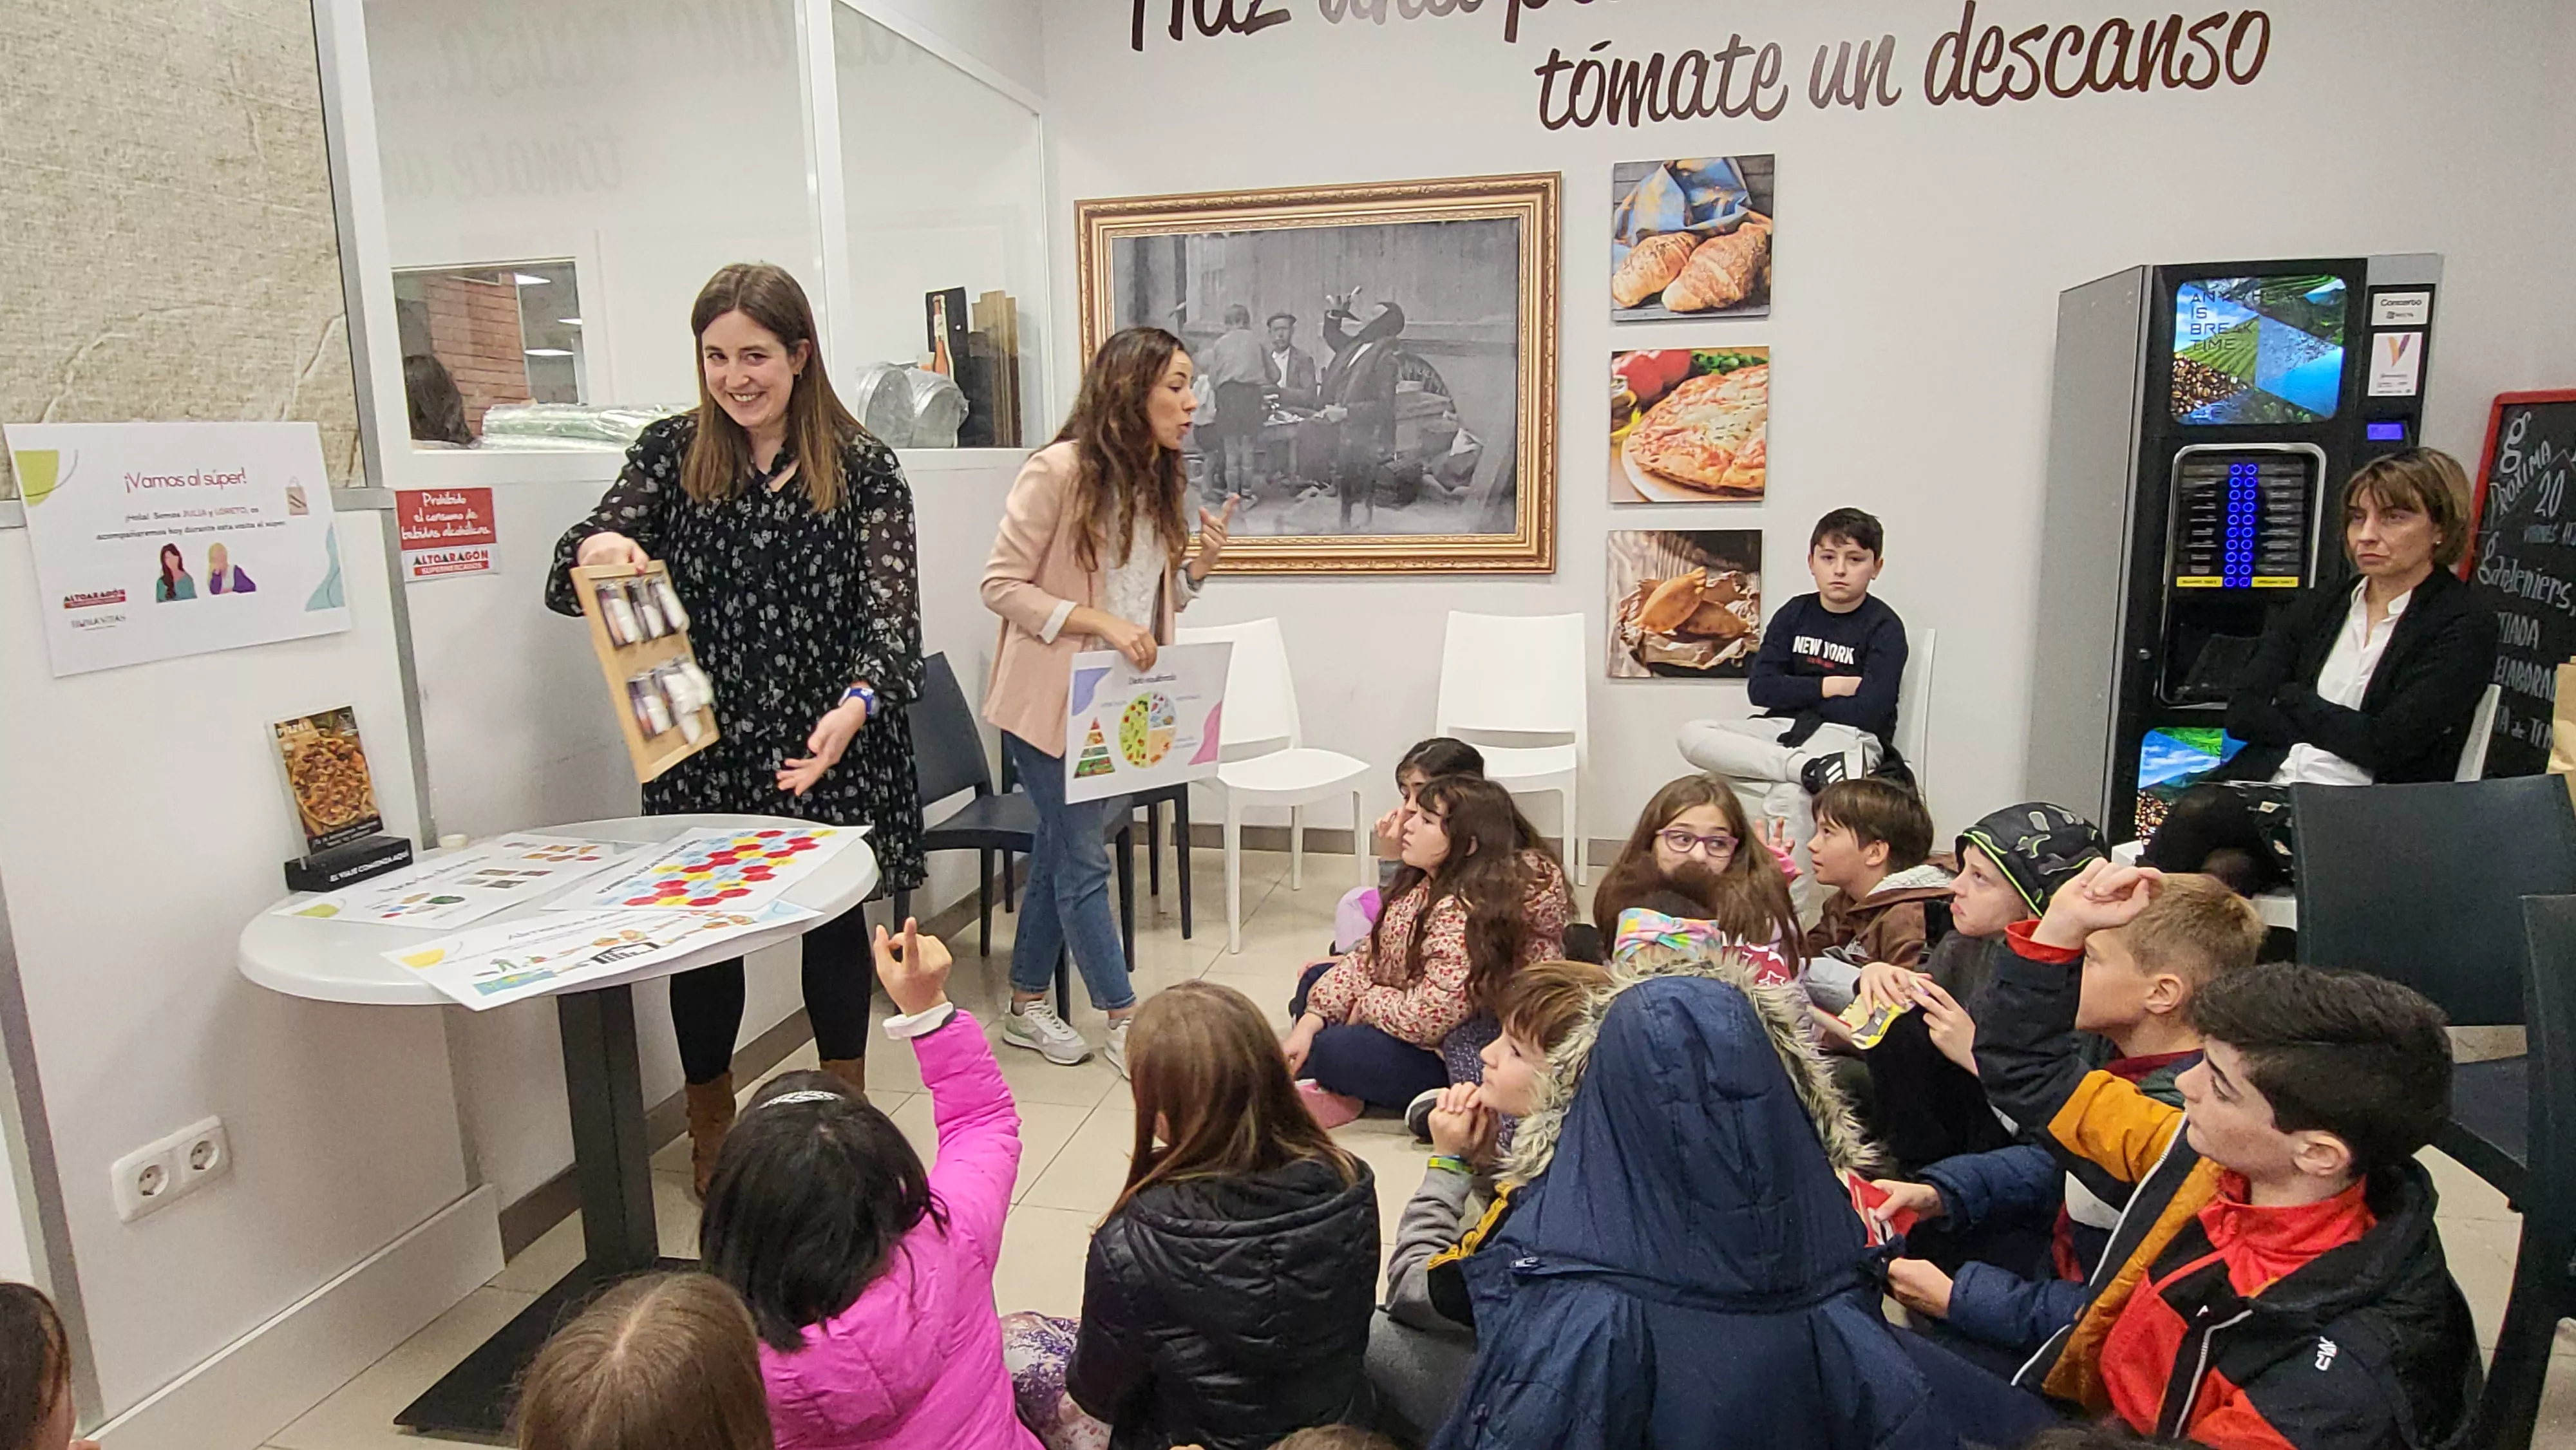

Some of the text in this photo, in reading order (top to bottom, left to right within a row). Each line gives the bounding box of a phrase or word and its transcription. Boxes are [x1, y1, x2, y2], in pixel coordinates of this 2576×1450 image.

[1535, 0, 2270, 130] tómate un descanso
[2191, 307, 2208, 319] IS
[2189, 339, 2236, 352] TIME
[124, 467, 247, 493] ¡Vamos al súper!
[2534, 470, 2565, 518] 20
[1792, 635, 1823, 656] NEW
[1823, 641, 1855, 664] YORK
